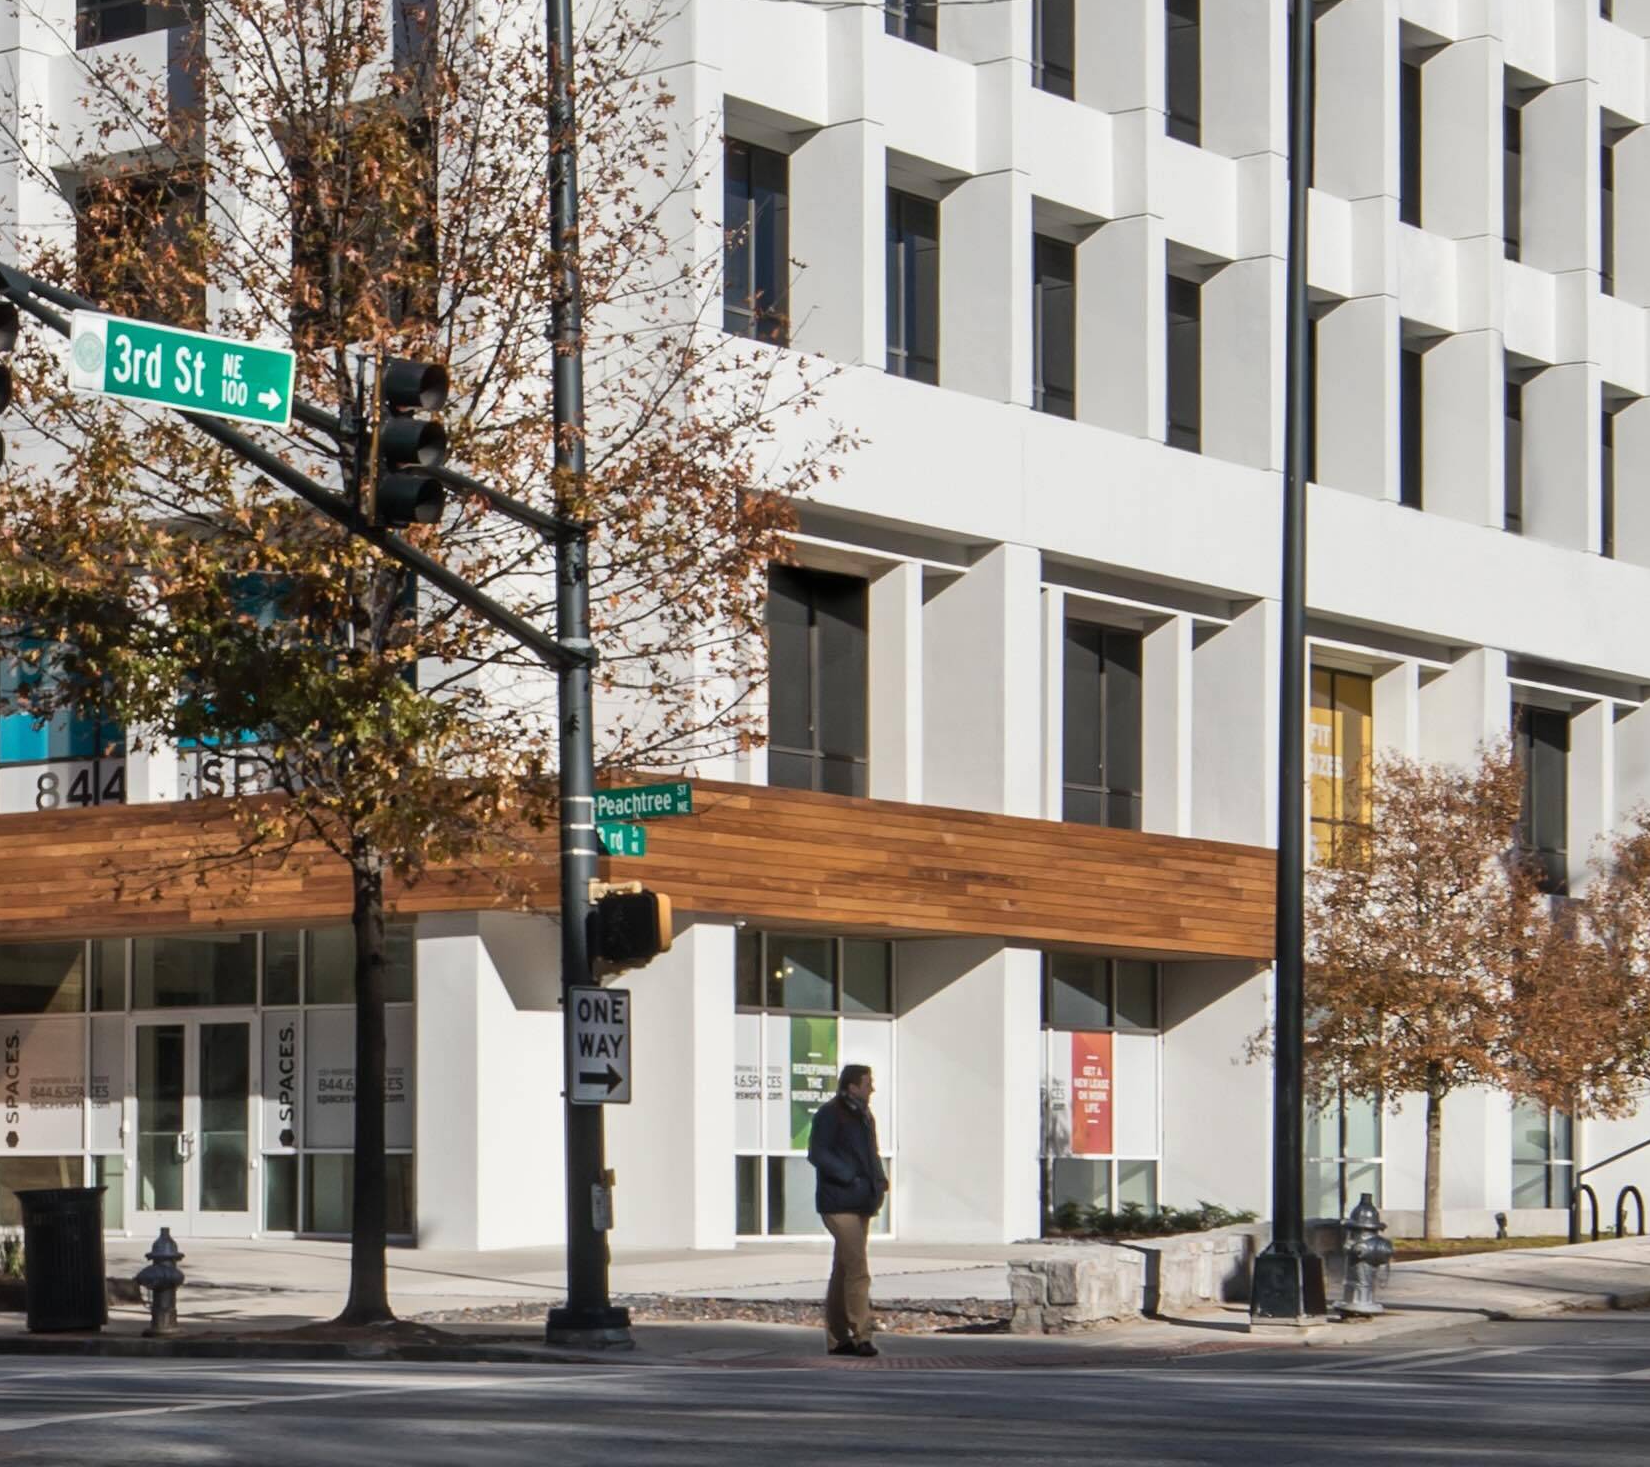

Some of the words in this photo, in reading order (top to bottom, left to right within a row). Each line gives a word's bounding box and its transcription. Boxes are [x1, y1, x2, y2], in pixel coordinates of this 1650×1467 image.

[112, 333, 163, 389] 3rd
[173, 345, 207, 398] St
[221, 352, 245, 380] NE
[221, 379, 249, 407] 100
[597, 792, 673, 817] Peachtree
[577, 997, 624, 1024] ONE
[577, 1032, 624, 1059] WAY
[5, 1029, 20, 1124] SPACES.
[278, 1021, 295, 1122] SPACES.
[806, 1076, 823, 1089] THE
